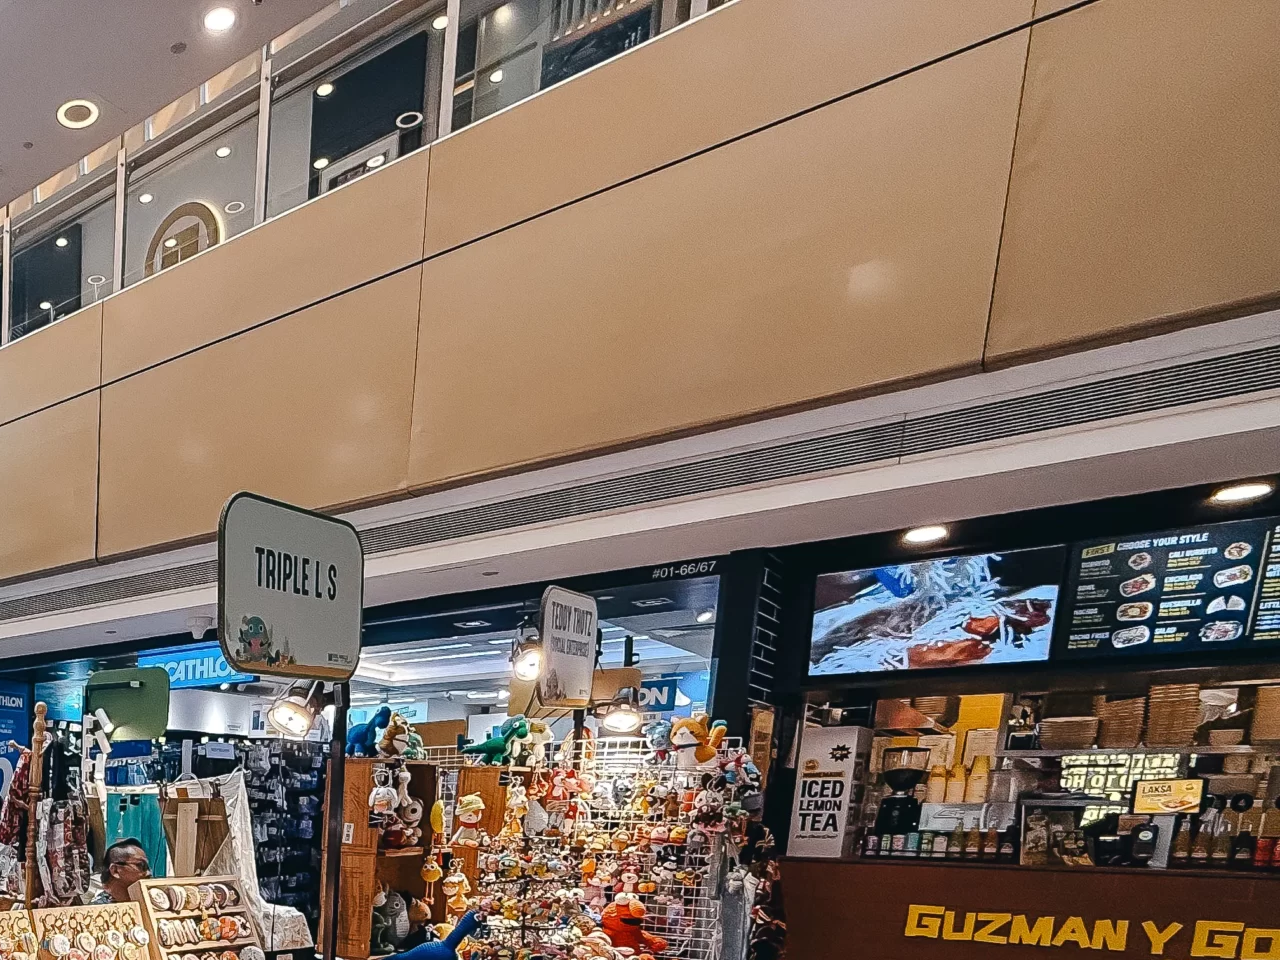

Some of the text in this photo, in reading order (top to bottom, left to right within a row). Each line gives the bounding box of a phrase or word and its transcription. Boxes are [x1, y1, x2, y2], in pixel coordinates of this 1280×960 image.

[1117, 540, 1151, 551] CHOOSE
[1153, 536, 1178, 547] YOUR
[1179, 532, 1209, 544] STYLE
[255, 546, 337, 600] TRIPLE L S
[652, 561, 716, 579] #01-66/67
[552, 600, 572, 632] TEDDY
[142, 655, 245, 682] CATHLO
[801, 780, 844, 798] ICED
[1142, 785, 1172, 794] LAKSA
[799, 800, 842, 811] LEMON
[799, 813, 838, 832] TEA
[905, 904, 1129, 950] GUZMAN
[1142, 920, 1183, 954] Y
